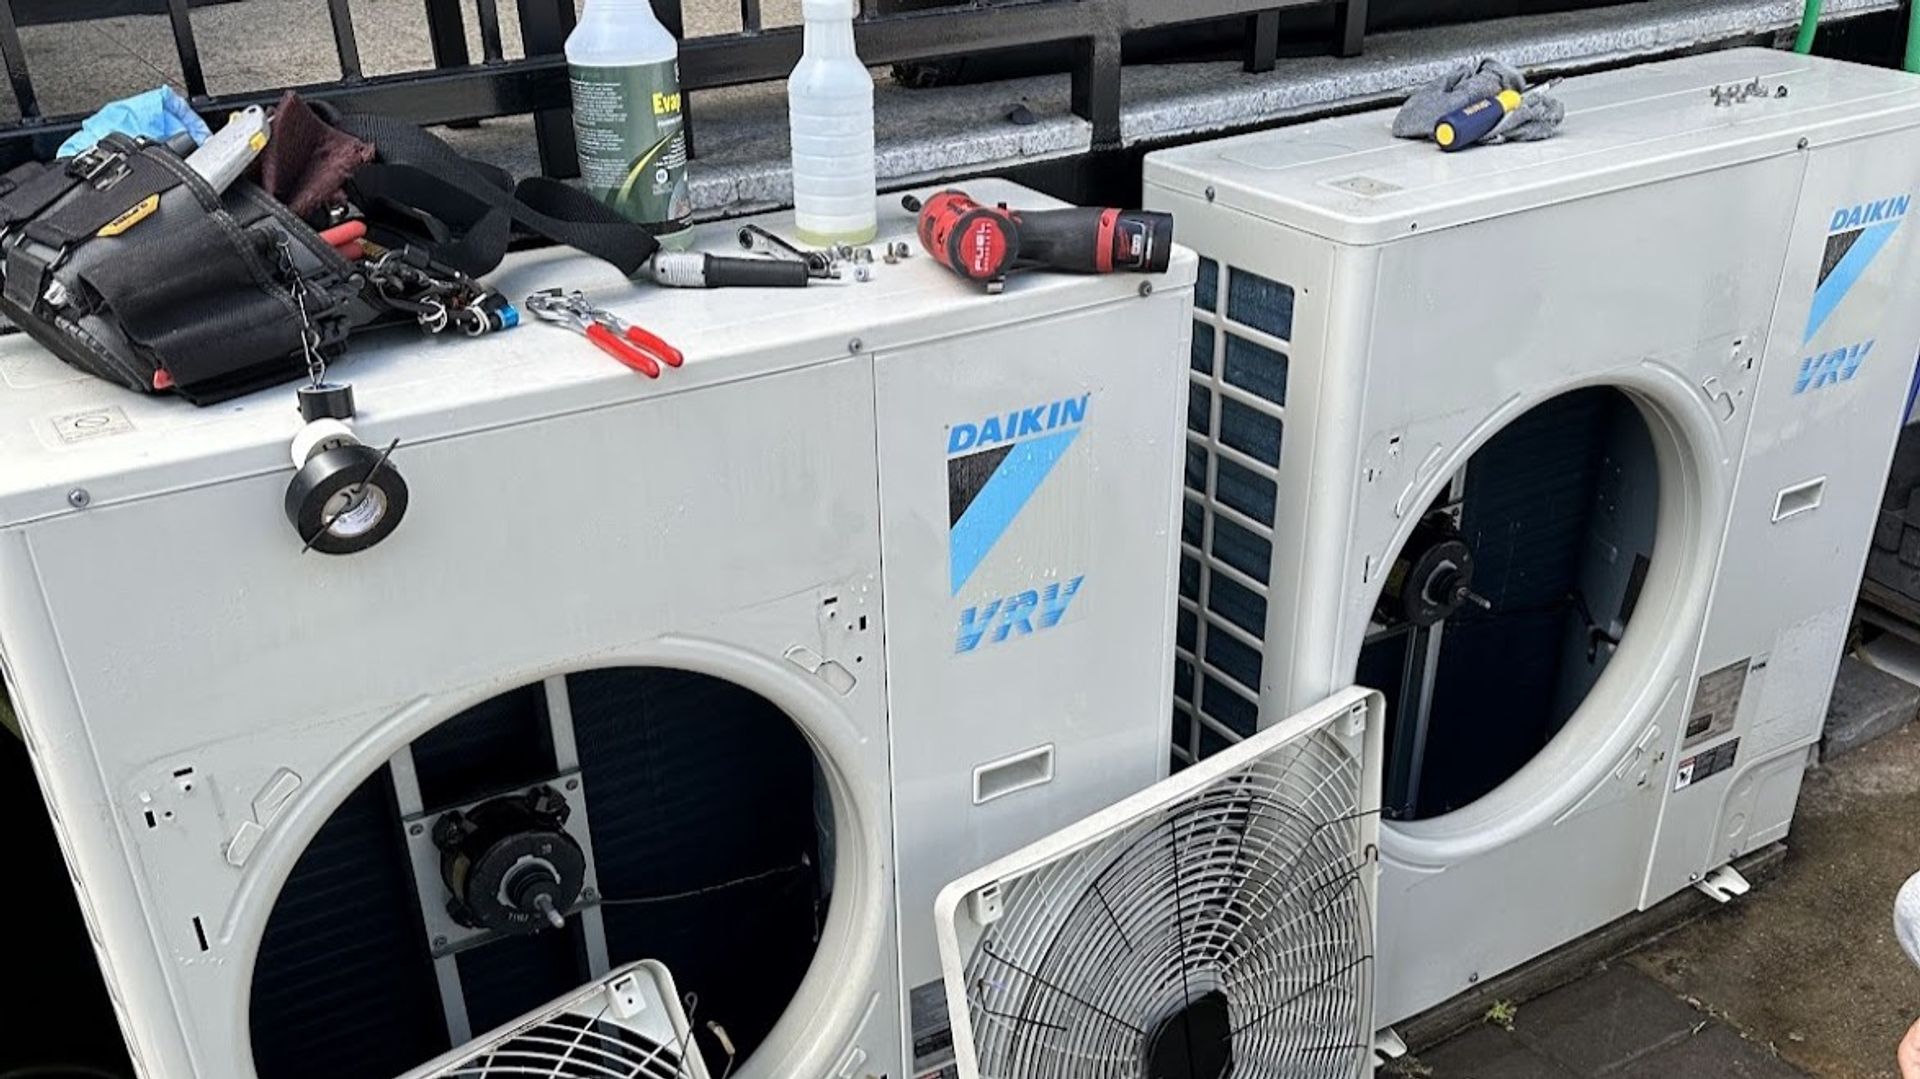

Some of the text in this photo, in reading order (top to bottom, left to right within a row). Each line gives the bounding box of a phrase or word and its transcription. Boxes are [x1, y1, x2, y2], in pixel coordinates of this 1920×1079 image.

[1829, 194, 1911, 231] DAIKIN
[975, 222, 986, 271] FUEL
[1792, 339, 1875, 395] VRV
[947, 395, 1088, 454] DAIKIN
[955, 575, 1085, 653] VRV
